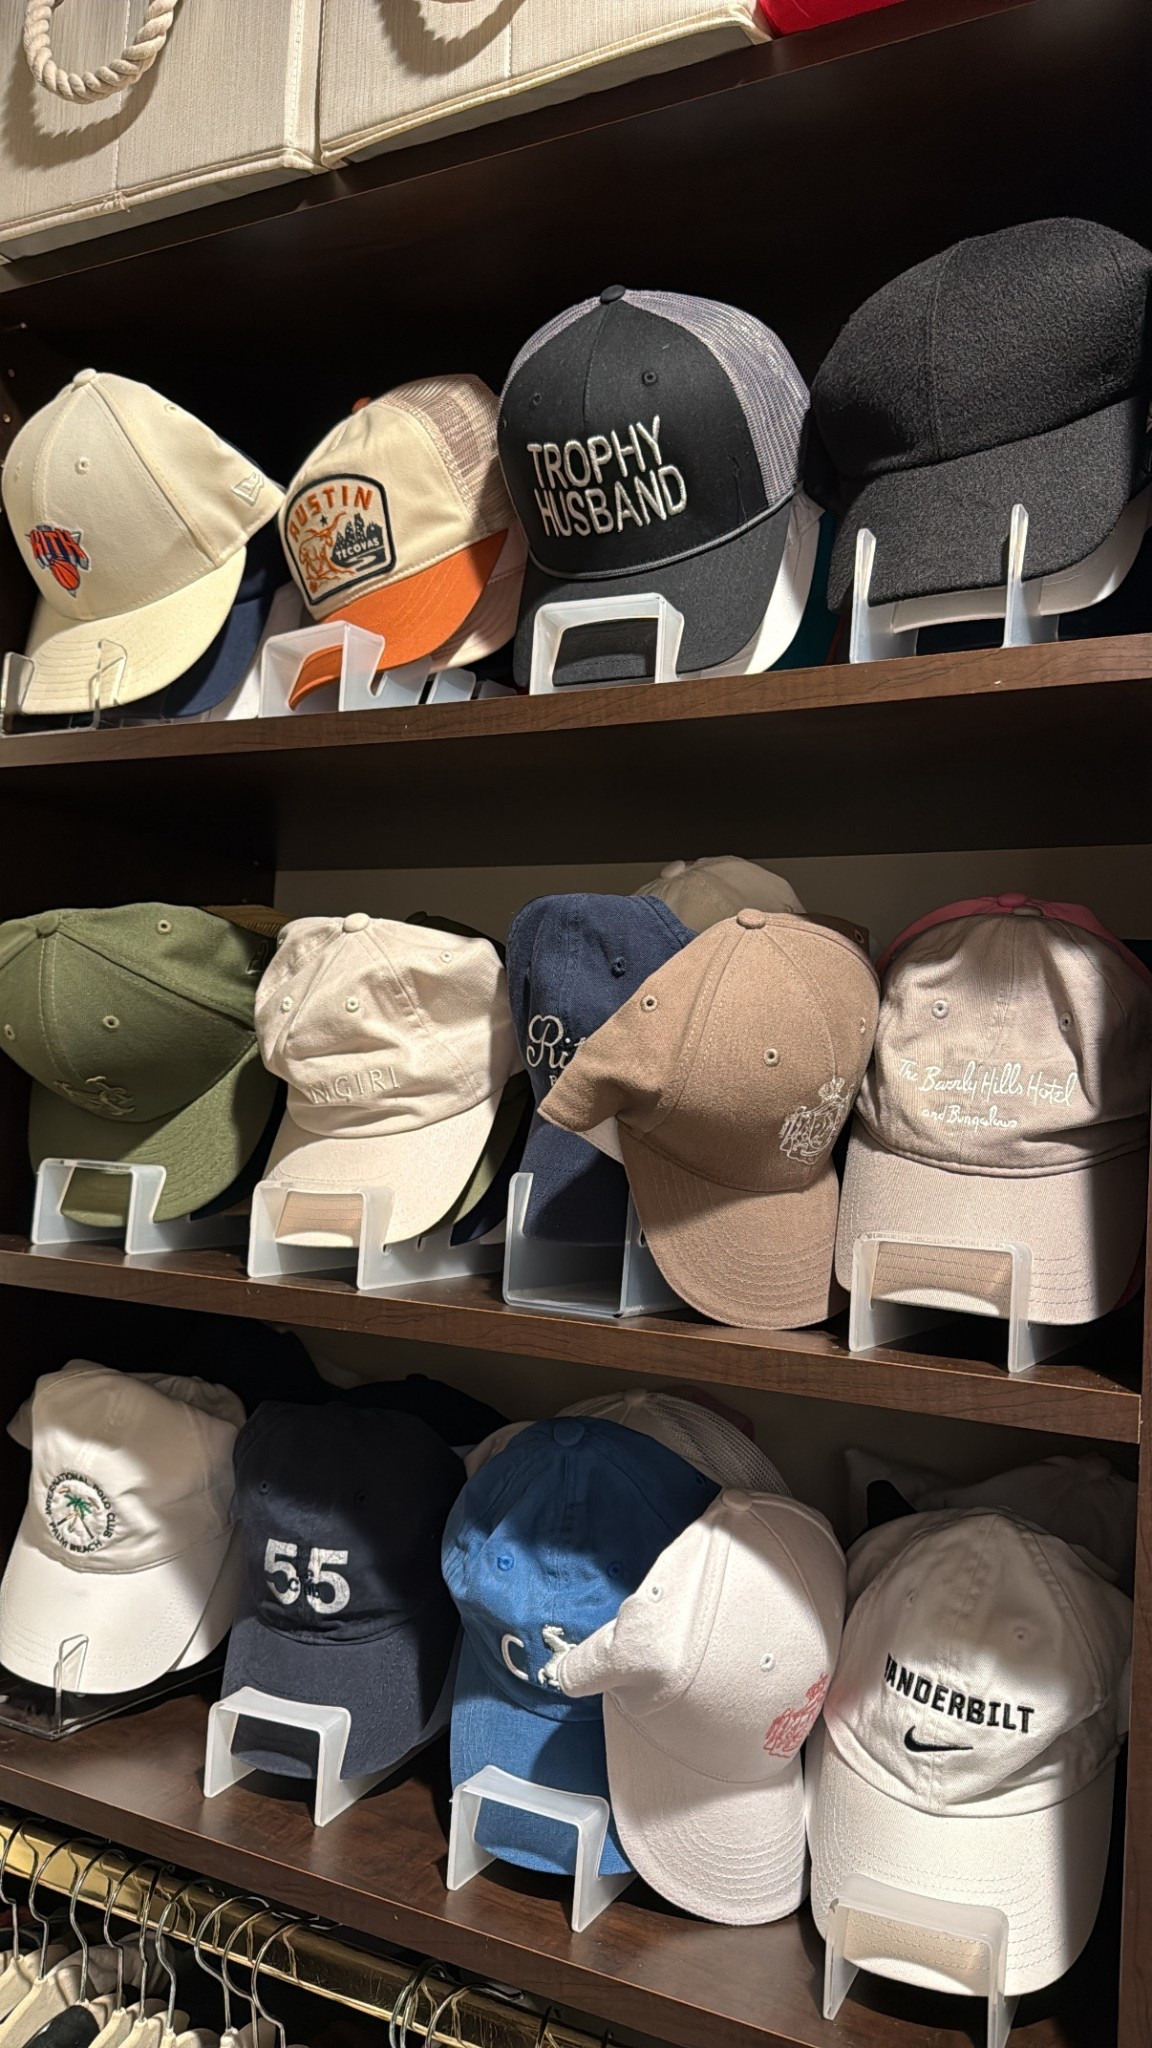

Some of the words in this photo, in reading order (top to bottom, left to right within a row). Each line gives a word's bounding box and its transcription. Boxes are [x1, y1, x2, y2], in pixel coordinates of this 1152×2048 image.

[527, 415, 662, 490] TROPHY
[289, 484, 374, 542] AUSTIN
[534, 464, 687, 537] HUSBAND
[335, 536, 380, 560] TECOVAS
[526, 1014, 587, 1069] Ri
[899, 1058, 918, 1082] The
[980, 1062, 1023, 1102] Hills
[1027, 1070, 1079, 1107] Hotel
[920, 1104, 948, 1122] and
[49, 1520, 69, 1548] PALM
[69, 1539, 103, 1554] BEACH
[92, 1483, 112, 1510] POLO
[103, 1512, 117, 1539] CLUB
[264, 1538, 351, 1615] 55
